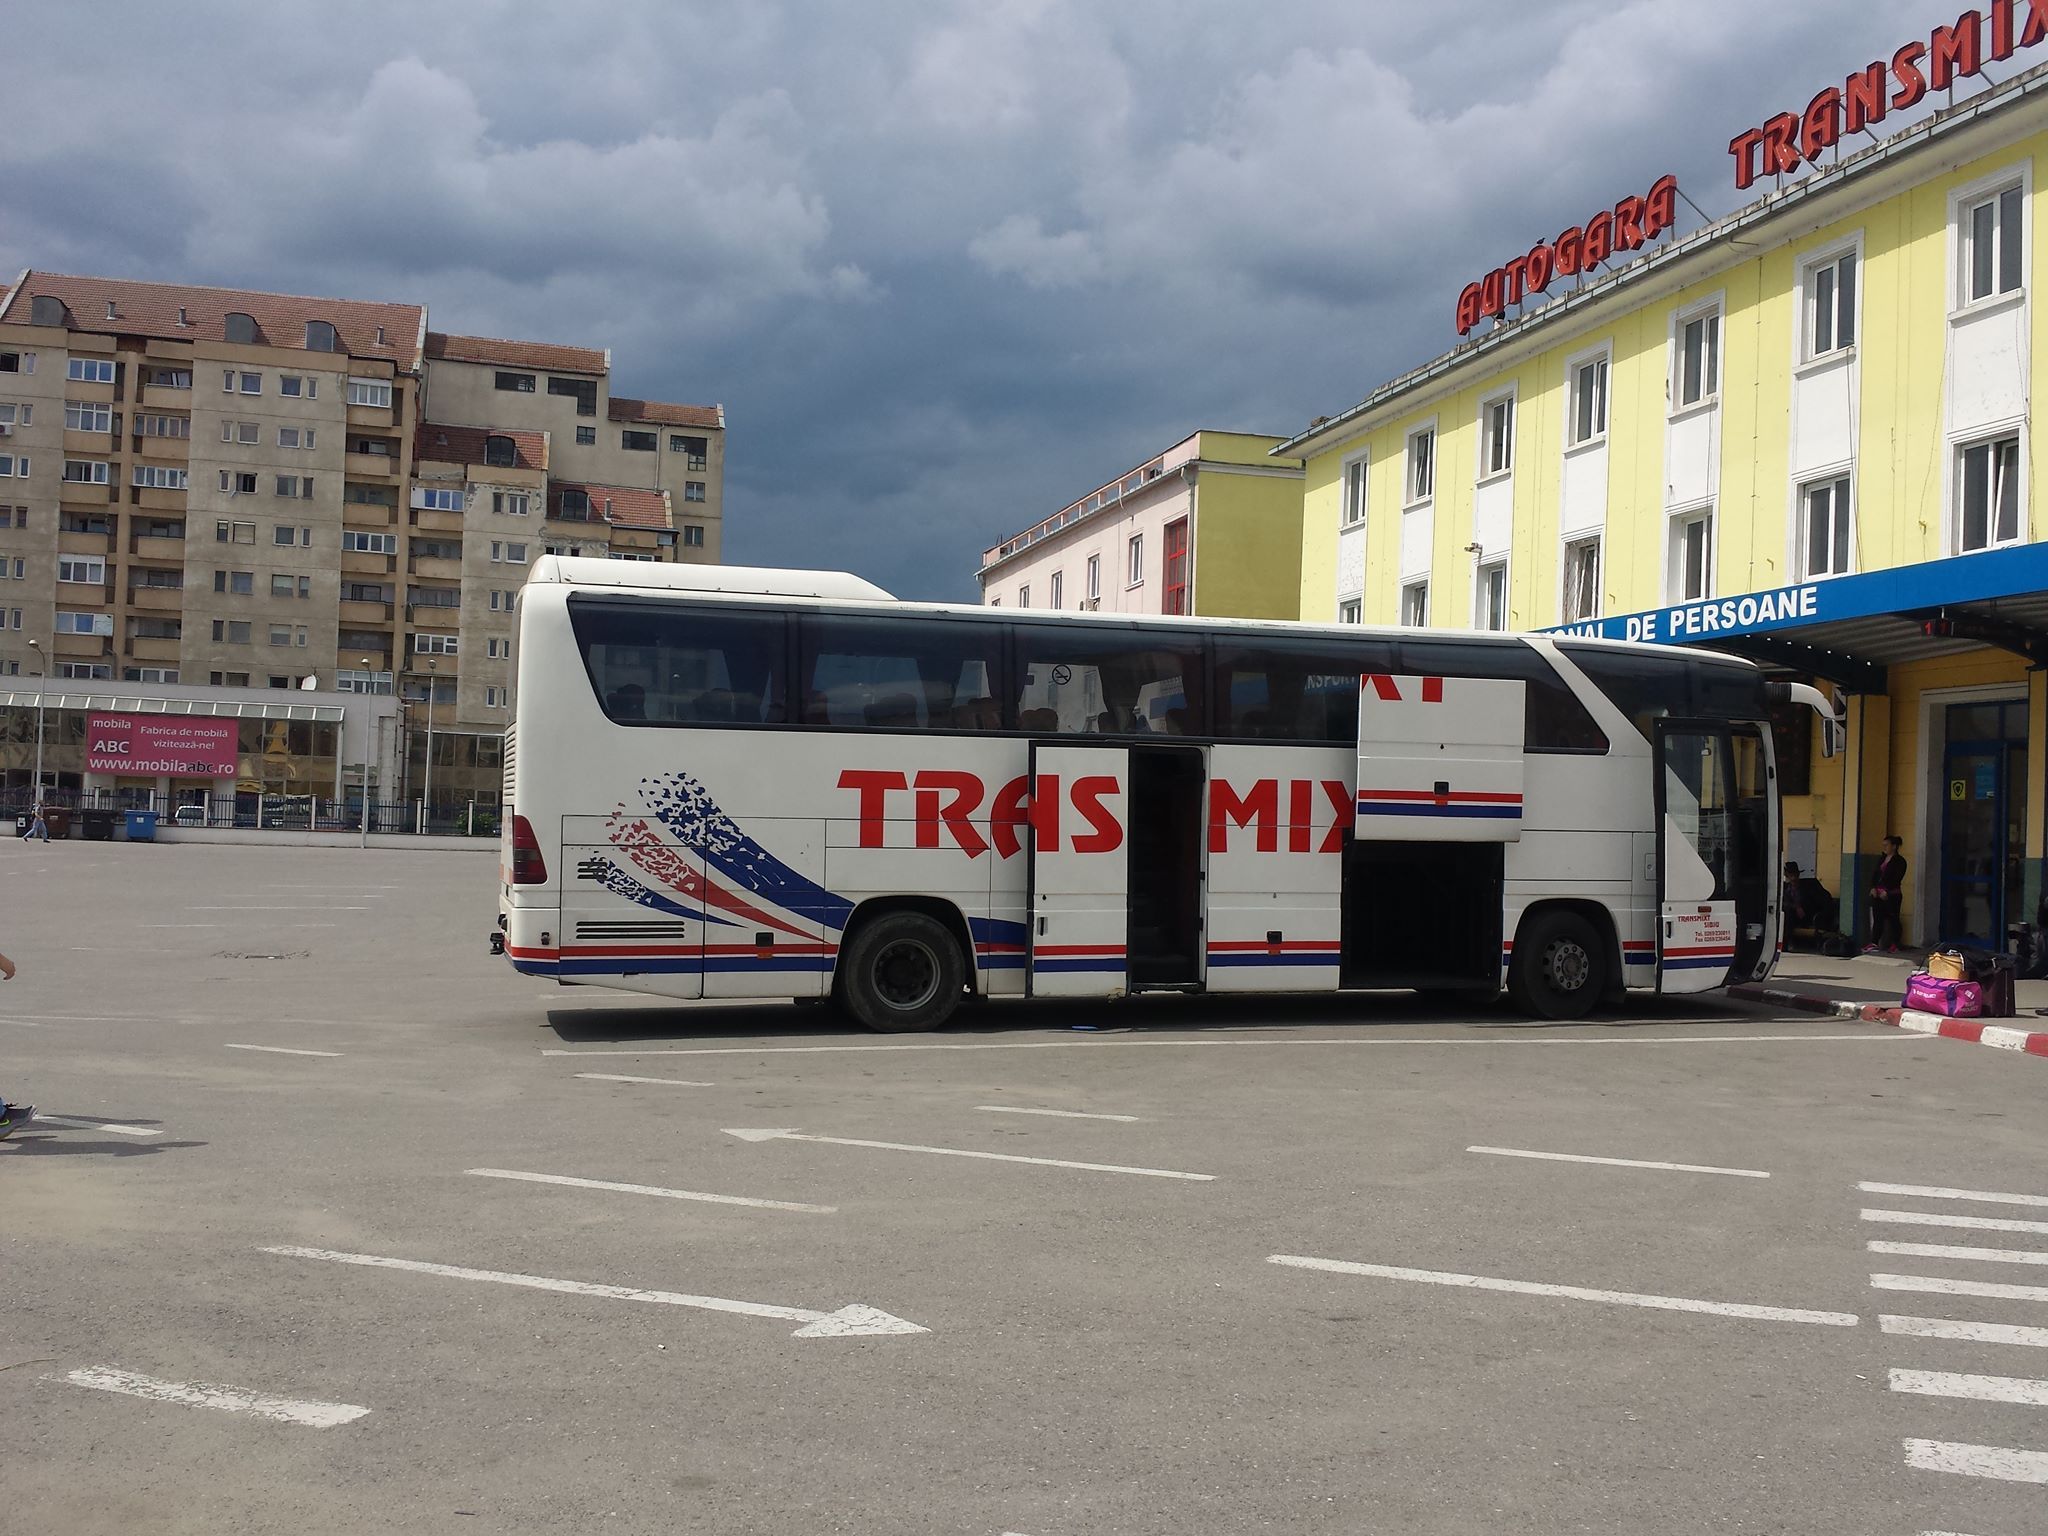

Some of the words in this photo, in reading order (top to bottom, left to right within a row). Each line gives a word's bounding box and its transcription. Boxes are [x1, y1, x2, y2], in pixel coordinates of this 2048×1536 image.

[1456, 174, 1677, 336] AUTOGARA
[1626, 614, 1656, 642] DE
[1670, 586, 1818, 637] PERSOANE
[92, 719, 132, 729] mobila
[140, 726, 177, 736] Fabrica
[179, 727, 192, 737] de
[93, 740, 130, 753] ABC
[89, 757, 234, 775] www.mobilaabc.ro
[1678, 915, 1711, 923] TRANSMIXT
